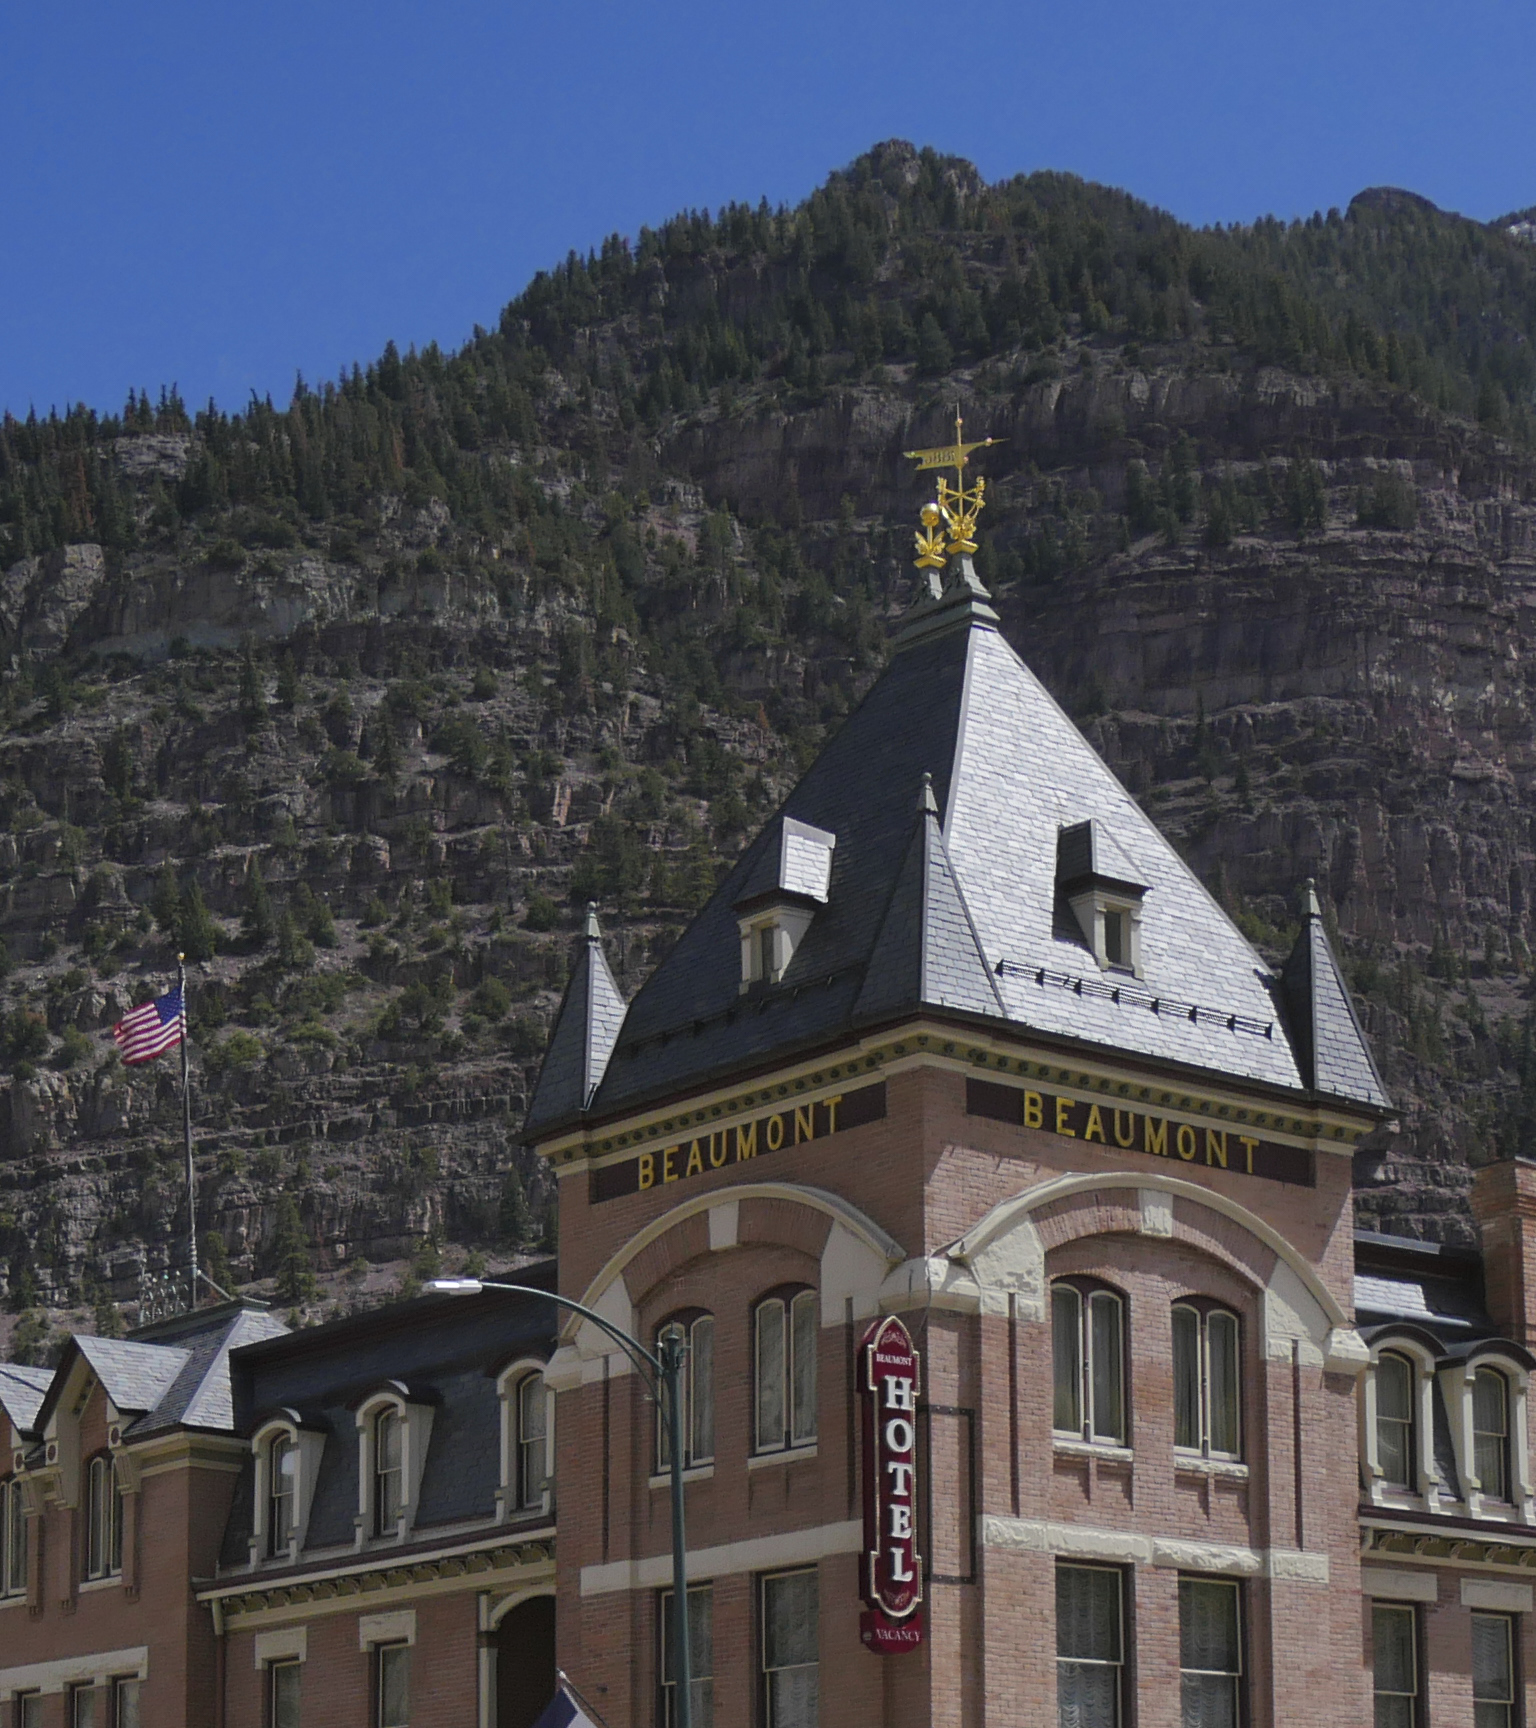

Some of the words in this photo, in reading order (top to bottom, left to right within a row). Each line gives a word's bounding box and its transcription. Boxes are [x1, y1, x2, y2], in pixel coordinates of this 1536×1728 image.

[638, 1094, 842, 1191] BEAUMONT
[1024, 1089, 1260, 1174] BEAUMONT
[876, 1353, 913, 1367] BEAUMONT
[883, 1374, 914, 1582] HOTEL
[876, 1628, 920, 1642] VACANCY
